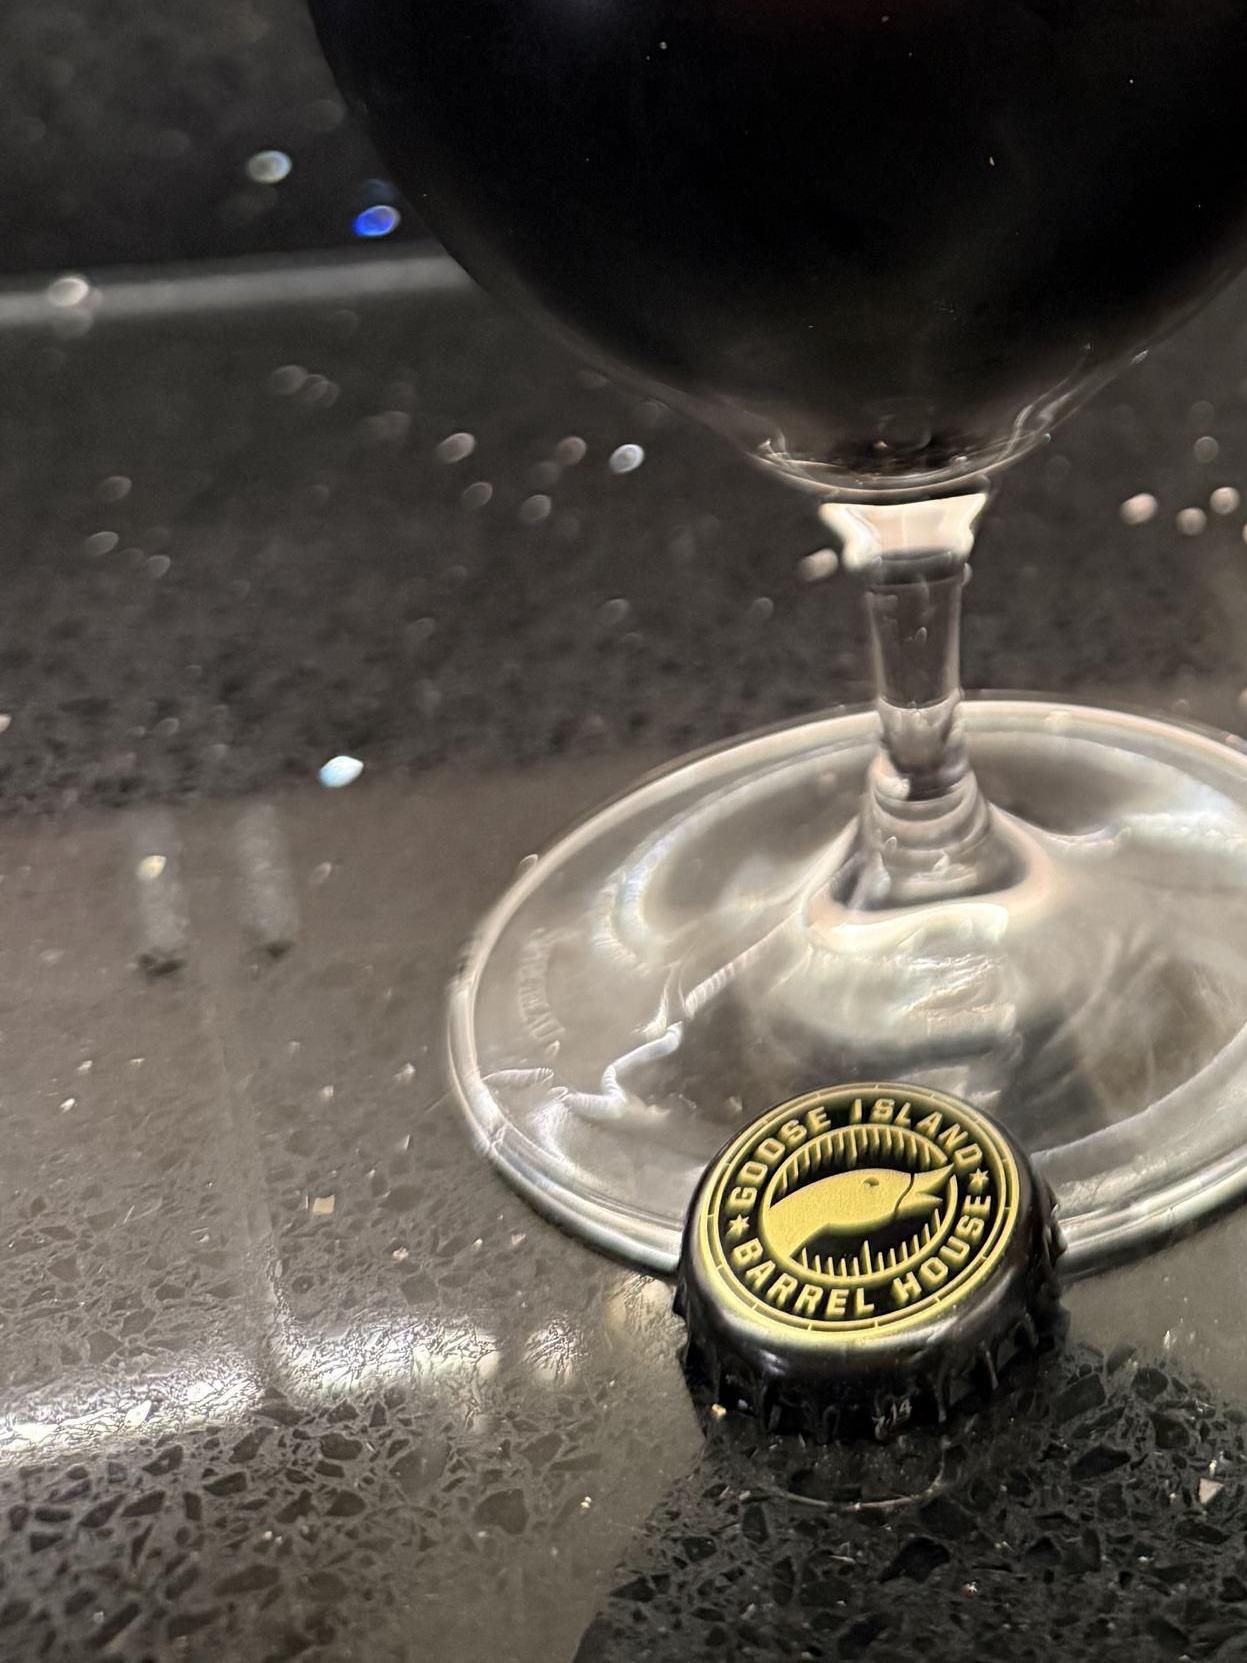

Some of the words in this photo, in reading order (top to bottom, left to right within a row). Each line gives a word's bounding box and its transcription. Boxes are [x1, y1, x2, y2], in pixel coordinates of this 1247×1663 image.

[729, 1105, 833, 1208] GOOSE
[848, 1097, 986, 1172] ISLAND
[731, 1237, 876, 1318] BARREL
[889, 1193, 993, 1308] HOUSE
